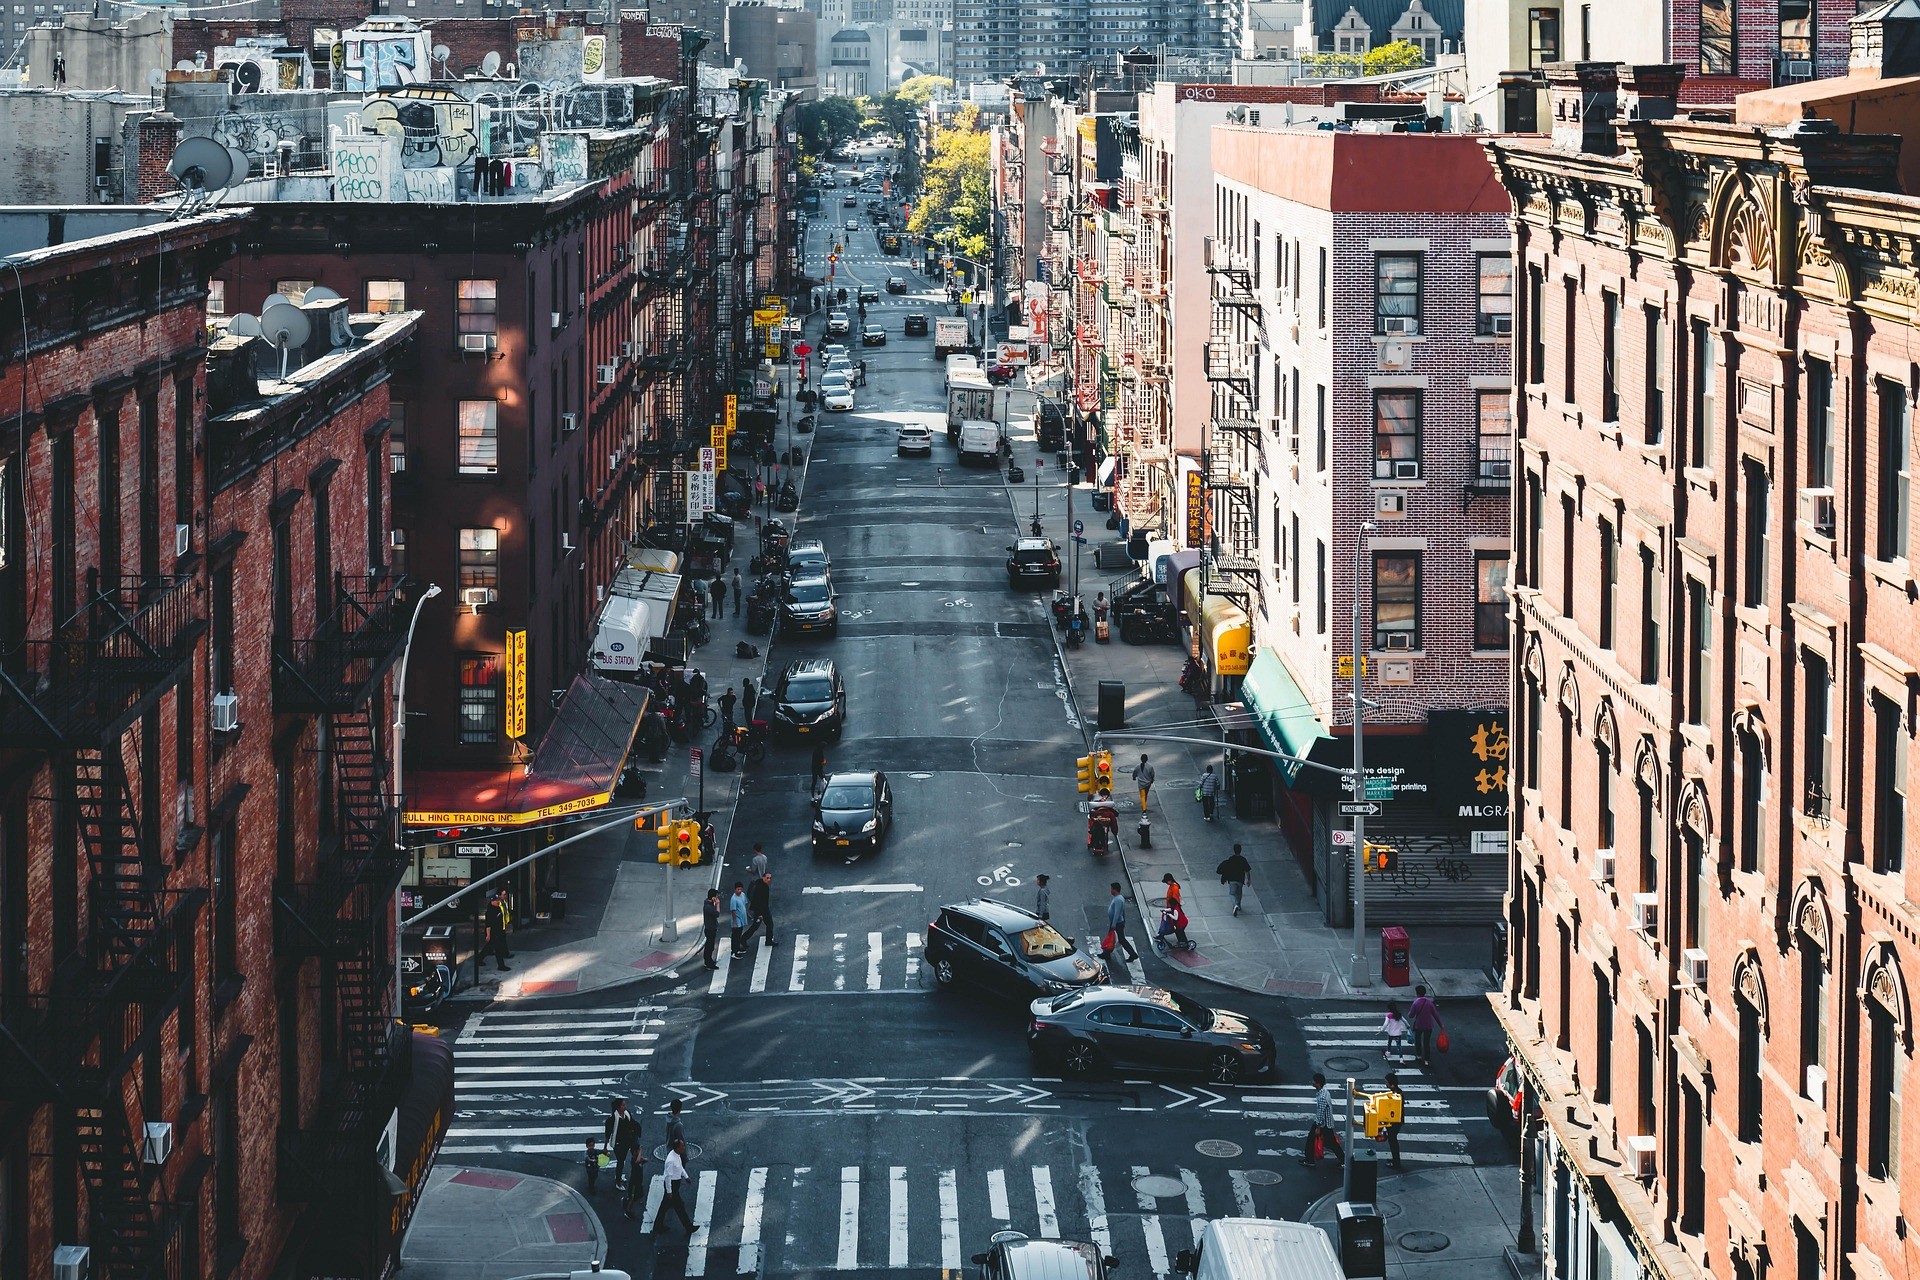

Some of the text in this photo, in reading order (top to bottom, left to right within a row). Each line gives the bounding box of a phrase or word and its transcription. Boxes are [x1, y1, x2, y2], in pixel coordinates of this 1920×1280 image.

[603, 656, 635, 665] BUS STATION
[1376, 767, 1405, 776] design
[1401, 783, 1427, 792] printing
[537, 798, 596, 818] TEL: 349-7036
[428, 813, 450, 822] HING
[453, 814, 495, 822] TRADING
[498, 814, 516, 822] INC.
